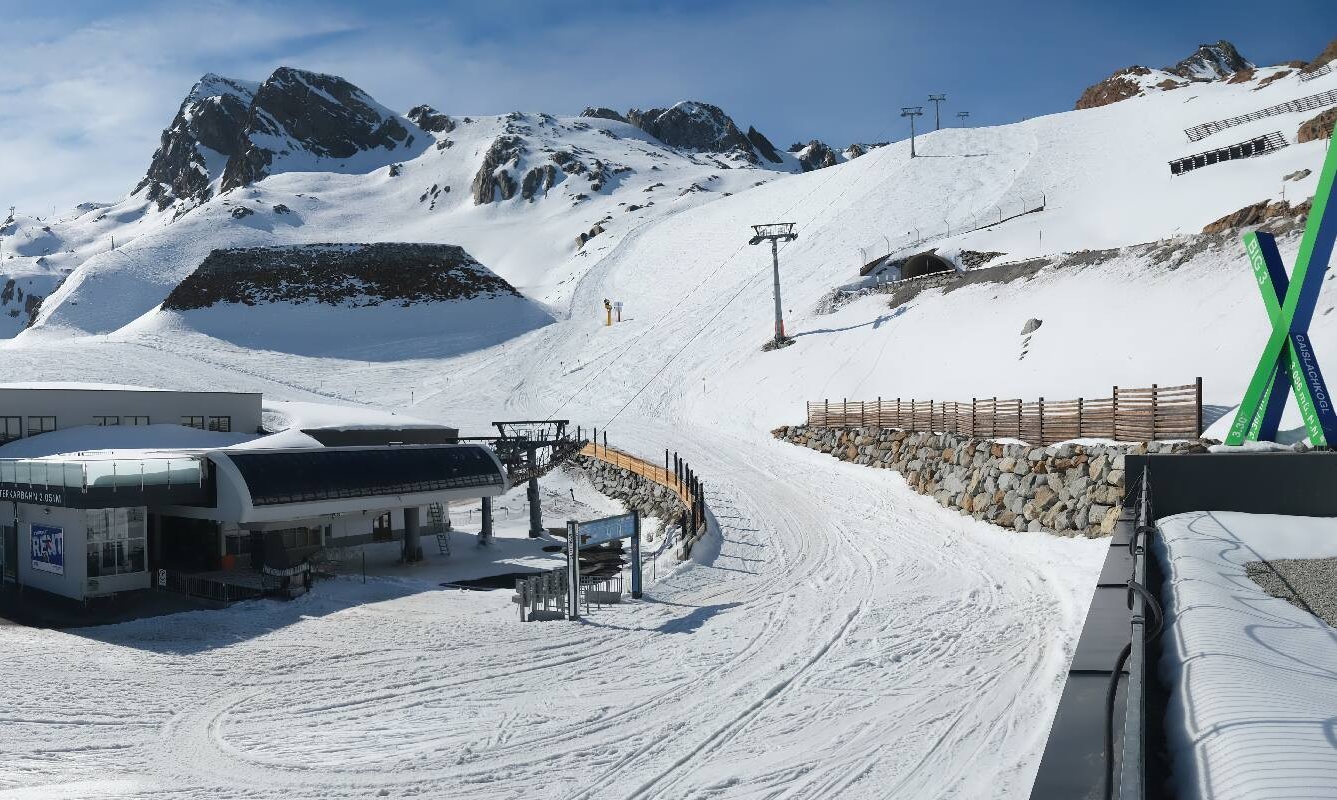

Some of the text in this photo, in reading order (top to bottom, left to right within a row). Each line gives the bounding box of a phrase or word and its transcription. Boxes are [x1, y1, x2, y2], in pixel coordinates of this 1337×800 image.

[1247, 238, 1267, 285] BIG 3
[1295, 335, 1329, 414] GAISLACHKOGL
